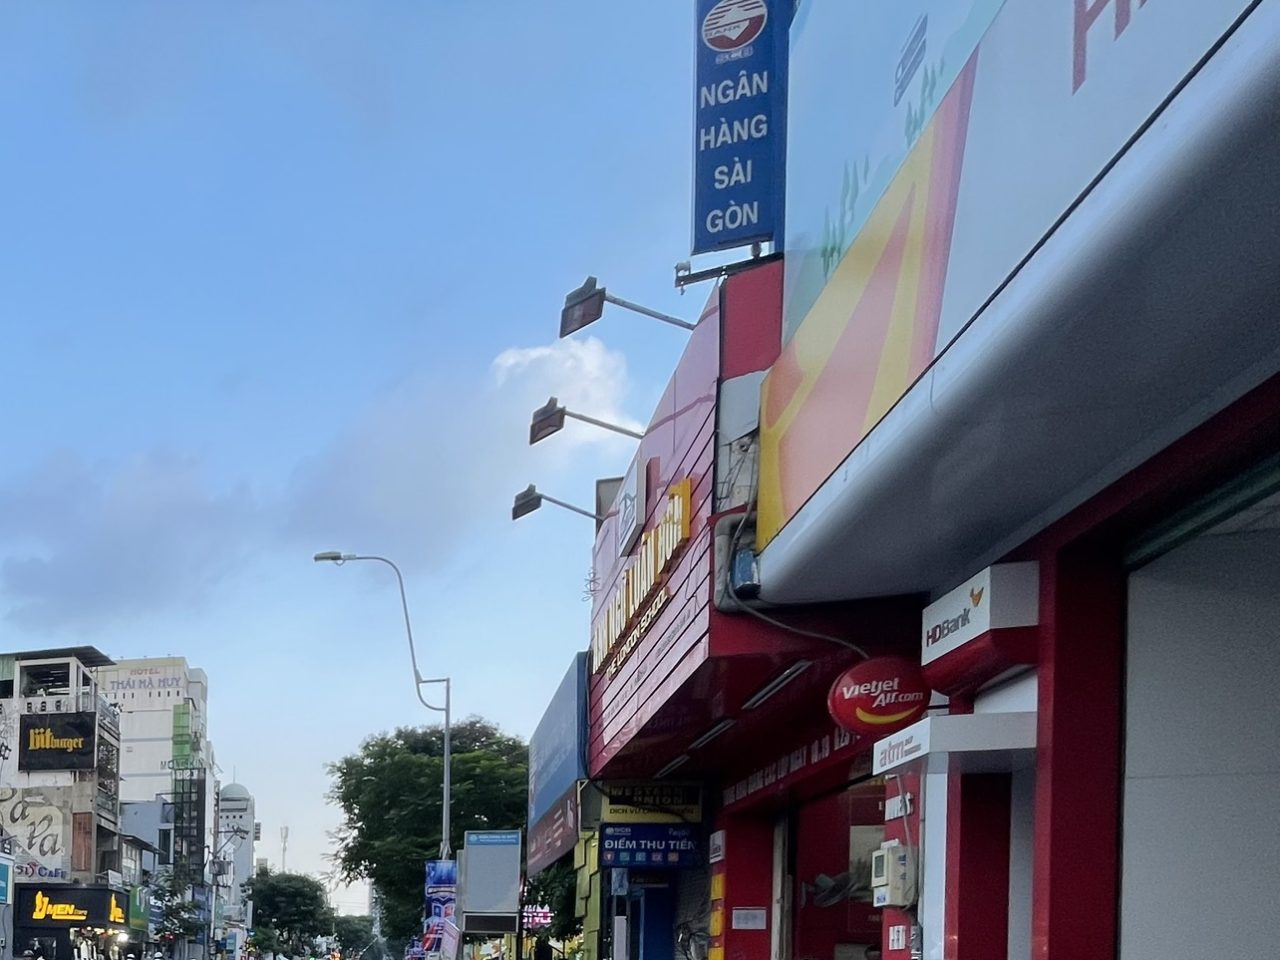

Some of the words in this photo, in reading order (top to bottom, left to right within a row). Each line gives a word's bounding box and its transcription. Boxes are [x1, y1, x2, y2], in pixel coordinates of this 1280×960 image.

[700, 69, 769, 108] NGÂN
[700, 114, 769, 151] HÀNG
[713, 156, 753, 190] SÀI
[705, 200, 759, 234] GÒN
[926, 607, 971, 647] HDBank
[110, 679, 136, 690] THÁI
[139, 677, 154, 689] HÀ
[158, 676, 181, 688] HUY
[130, 667, 160, 676] HOTEL
[842, 677, 900, 699] Vietjet
[871, 691, 924, 708] Air.com
[604, 837, 637, 849] ĐIỂM
[639, 840, 666, 850] THU
[668, 838, 697, 850] TIỀN
